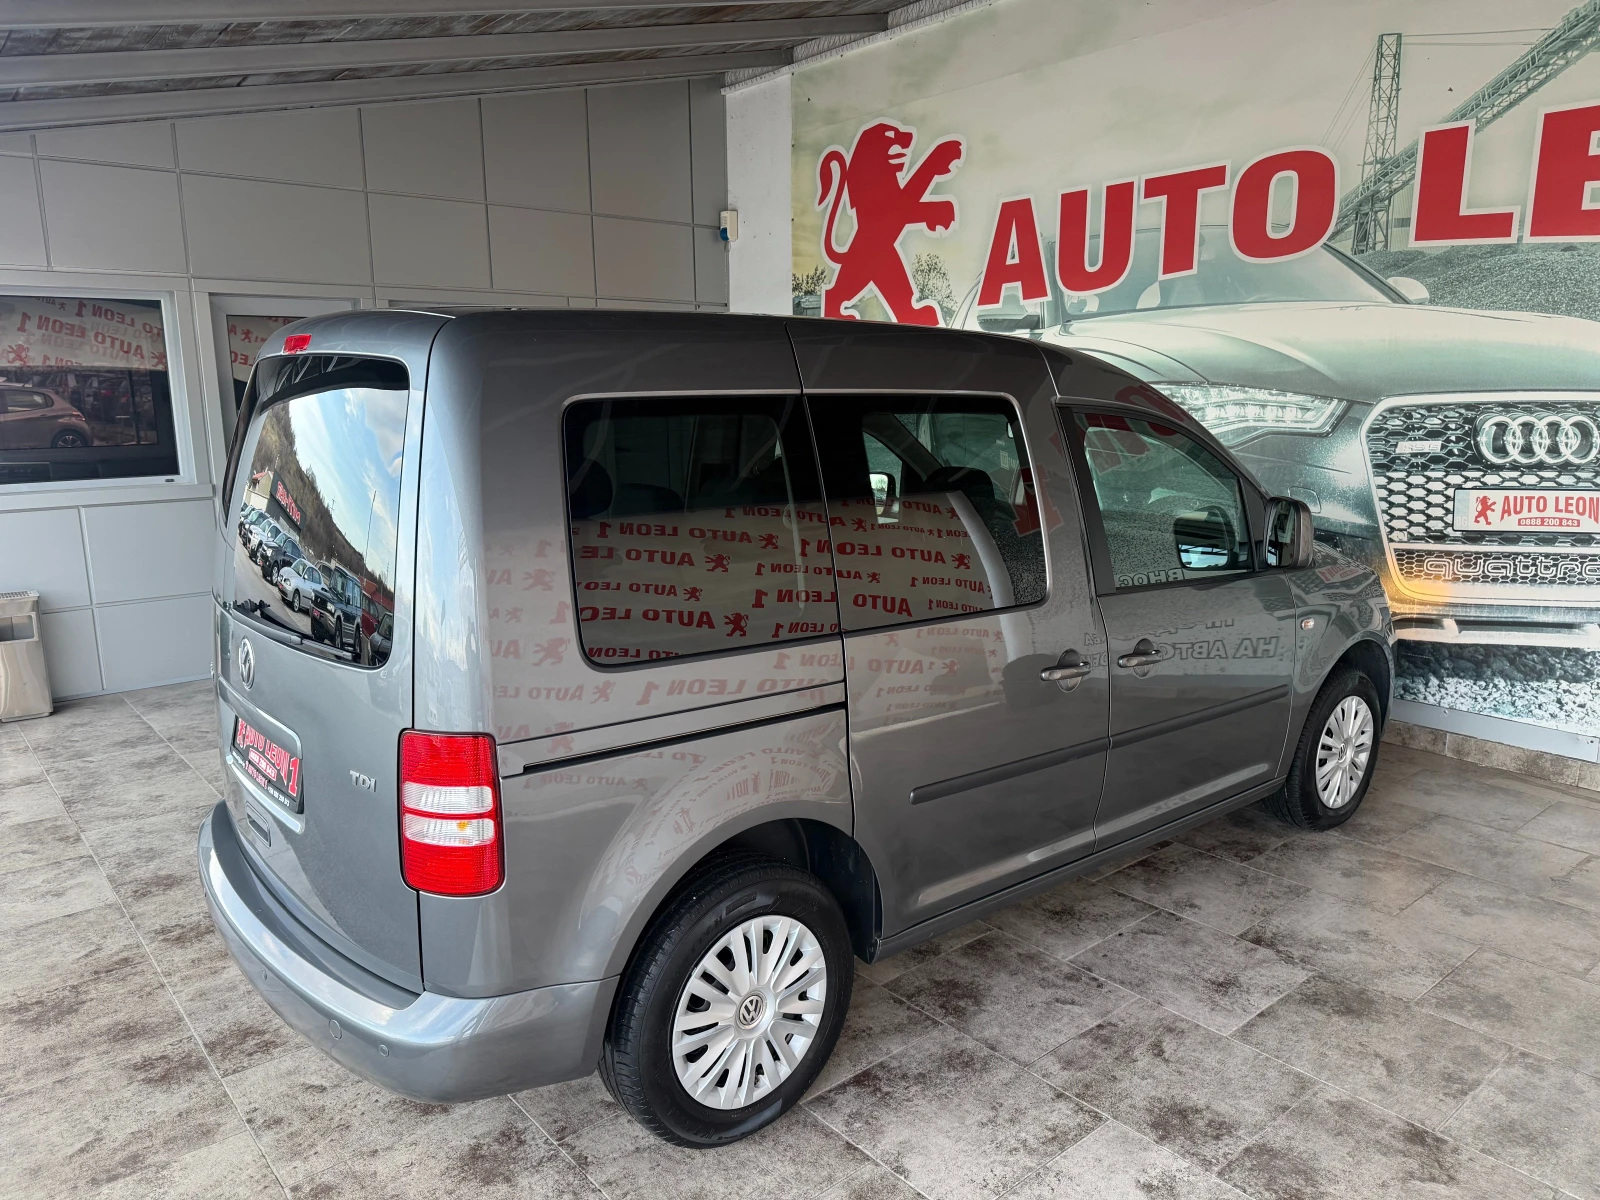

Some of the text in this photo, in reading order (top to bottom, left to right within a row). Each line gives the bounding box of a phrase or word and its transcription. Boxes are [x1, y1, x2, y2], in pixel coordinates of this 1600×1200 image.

[976, 103, 1600, 309] AUTO LE
[1500, 495, 1600, 525] AUTO LEON
[1520, 518, 1579, 527] 0888 200 843
[265, 739, 291, 786] LEON
[288, 757, 299, 797] 1
[350, 770, 377, 792] TDI
